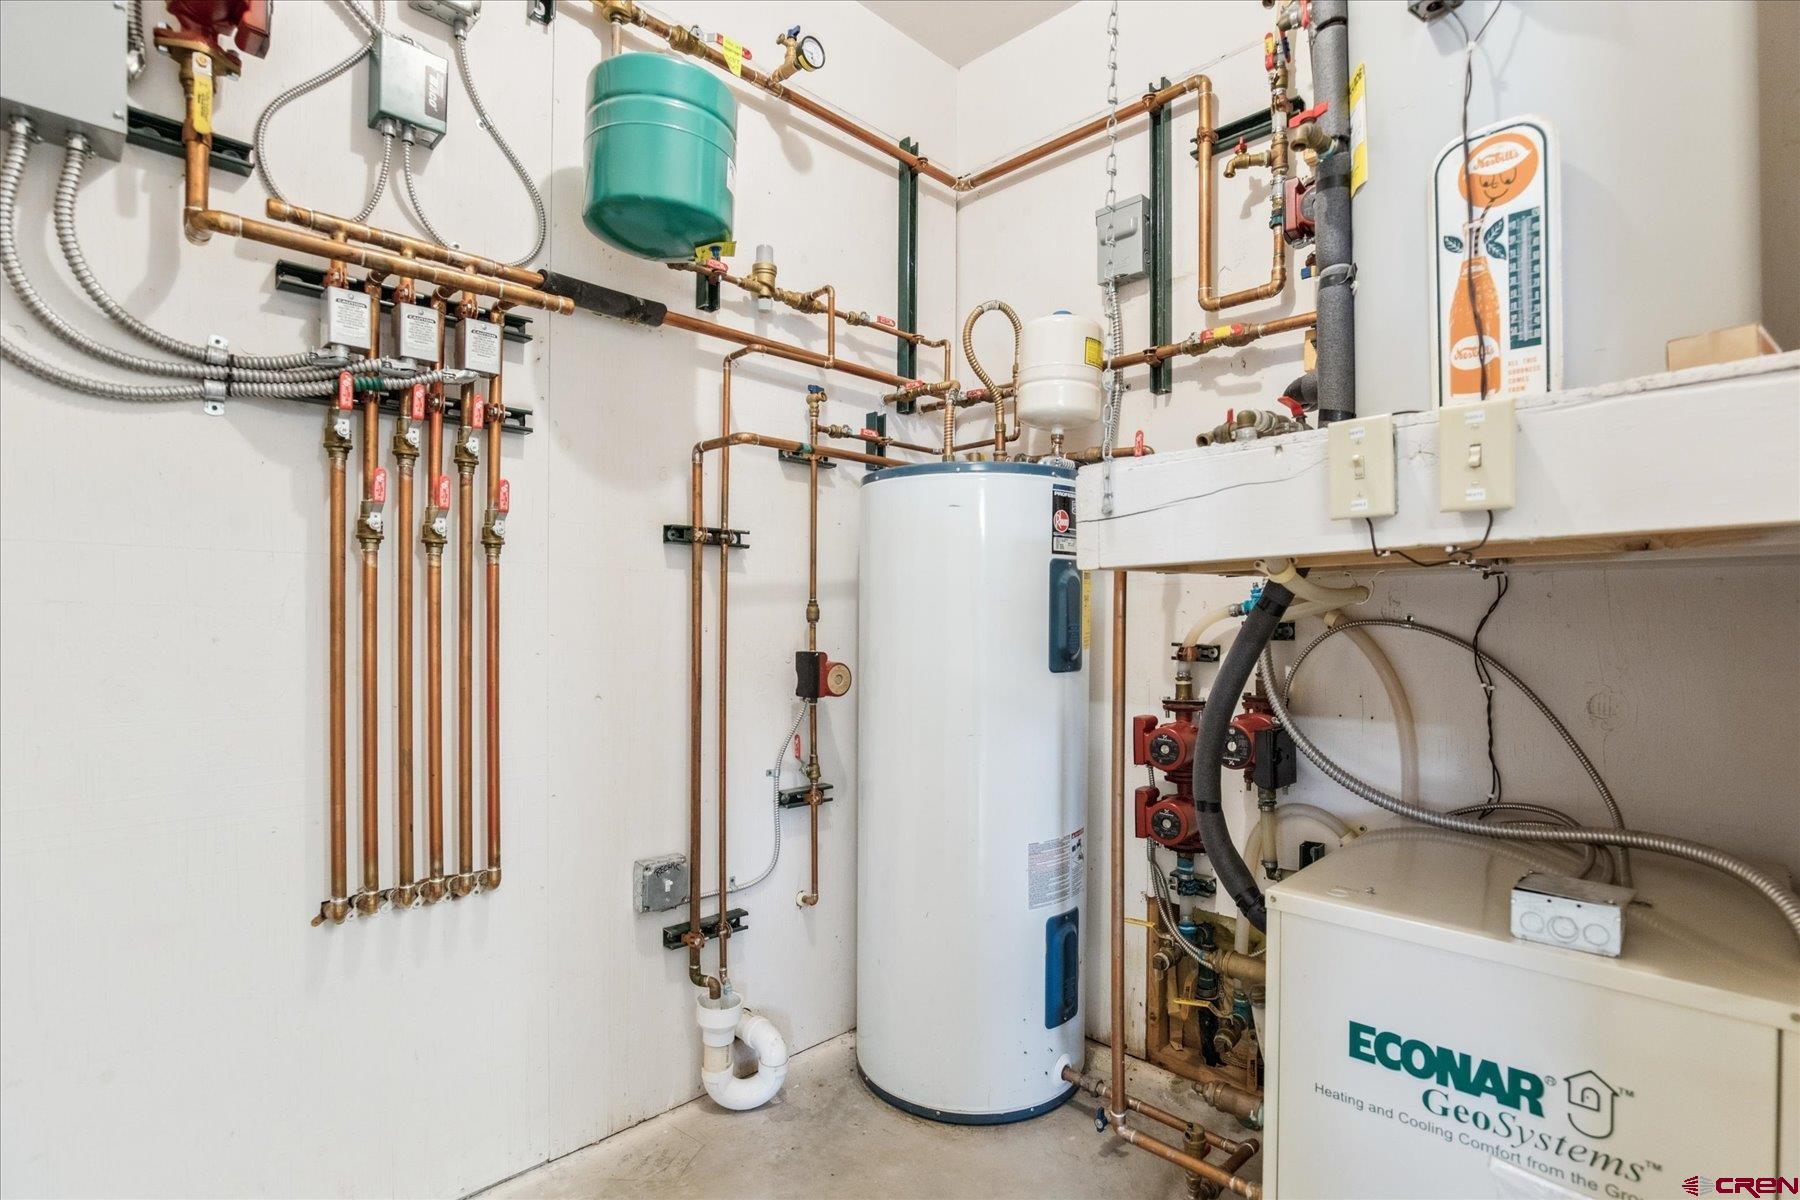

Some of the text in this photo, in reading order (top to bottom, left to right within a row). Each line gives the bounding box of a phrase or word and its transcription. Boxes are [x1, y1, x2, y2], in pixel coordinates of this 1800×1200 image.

[1314, 1083, 1644, 1200] Heating and Cooling Comfort from the Gro
